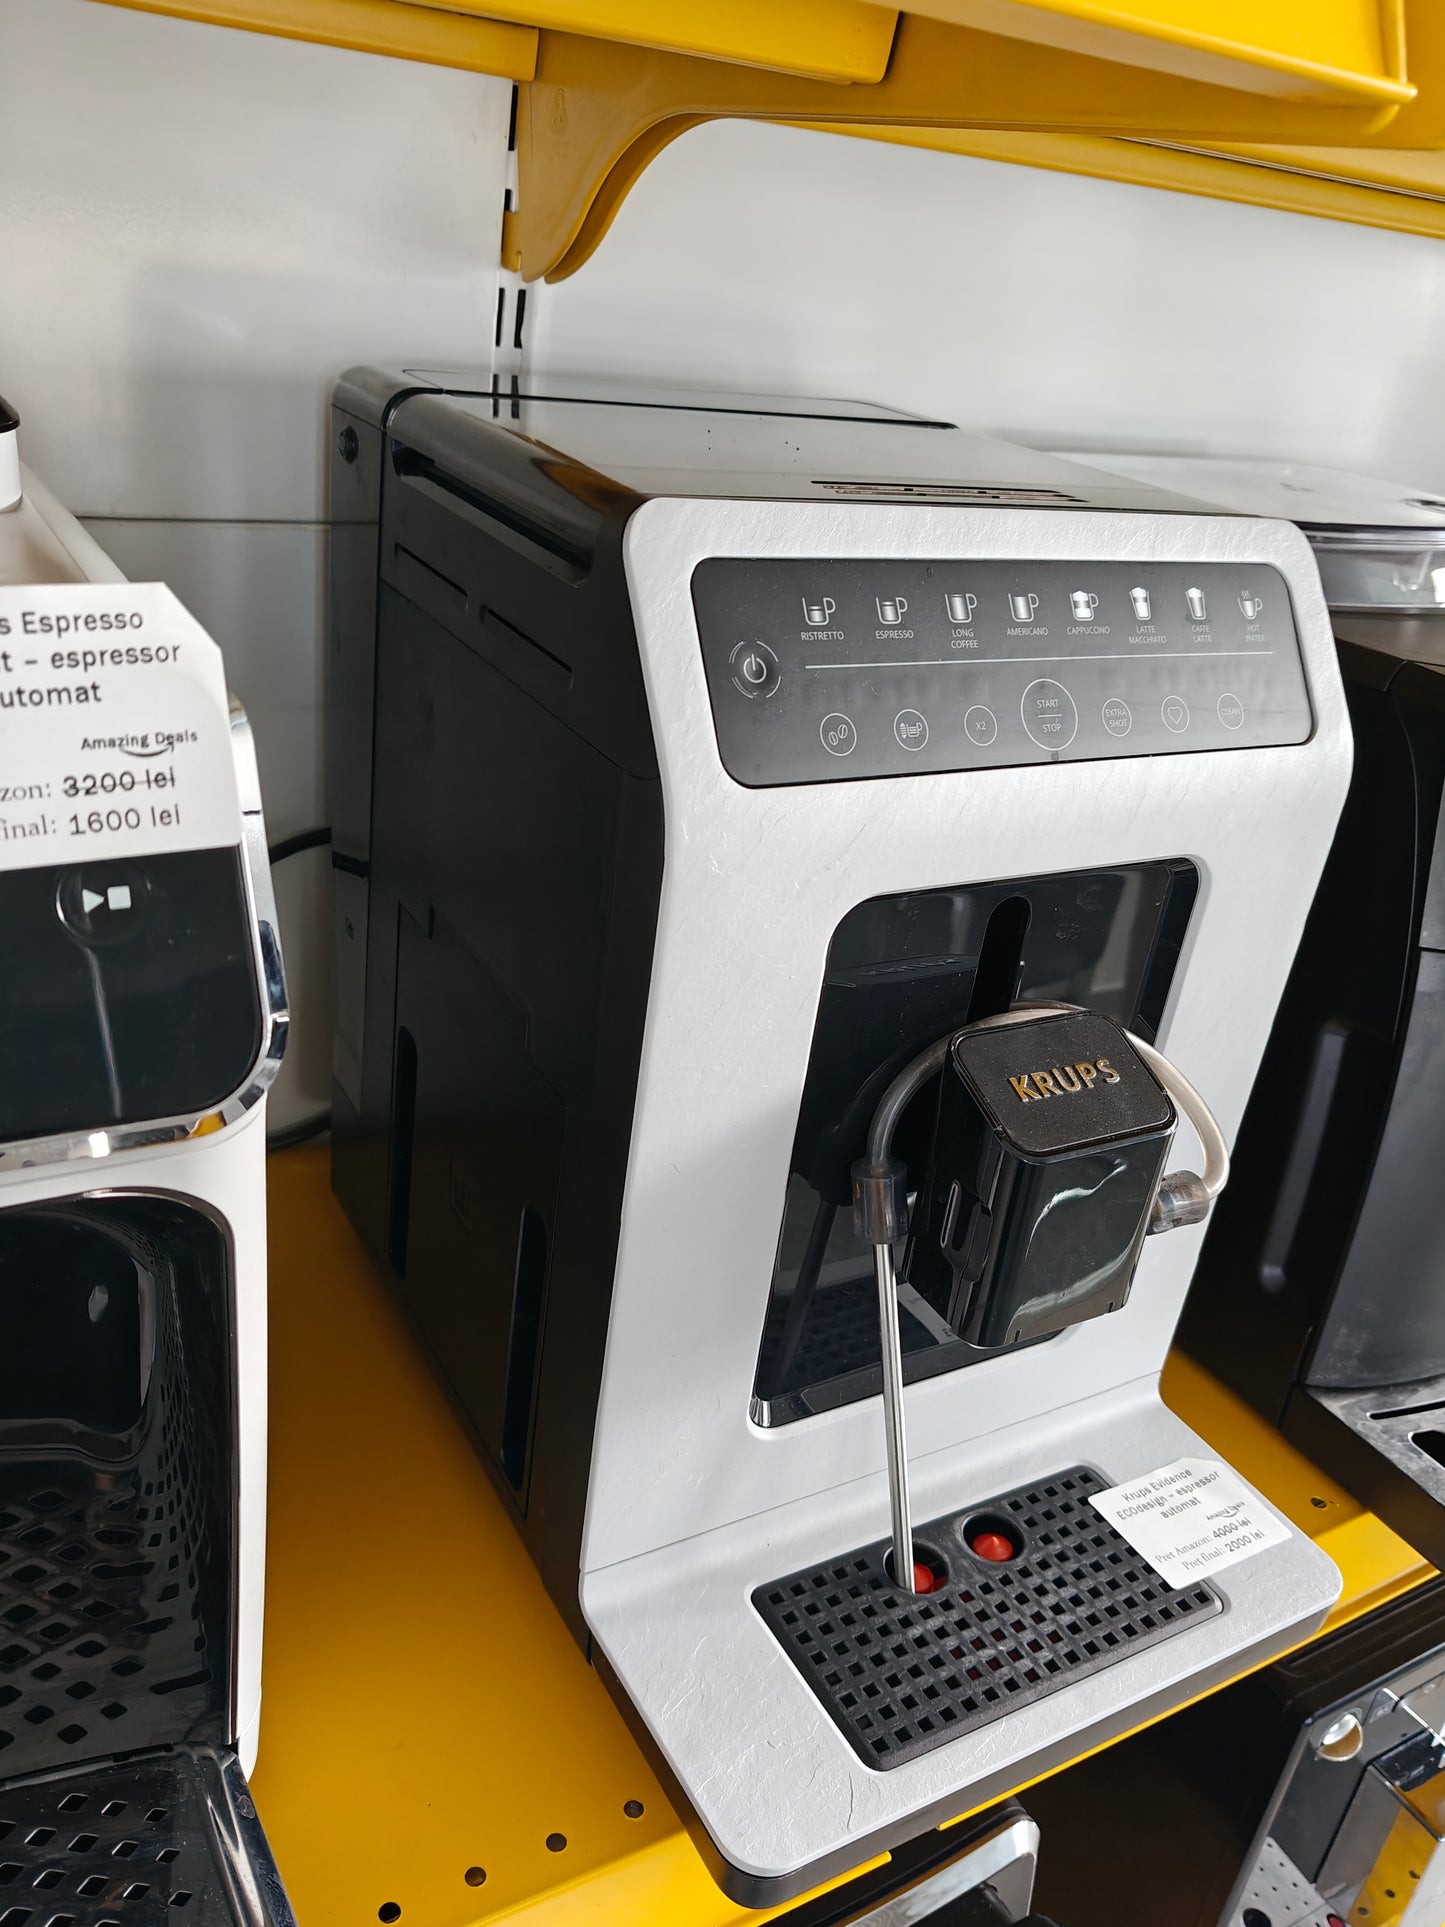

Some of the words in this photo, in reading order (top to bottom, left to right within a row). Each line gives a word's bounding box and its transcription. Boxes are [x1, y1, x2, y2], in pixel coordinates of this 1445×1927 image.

[22, 611, 143, 638] Espresso
[1192, 624, 1210, 633] CAFFE
[1247, 624, 1259, 633] HOT
[952, 629, 974, 637] LONG
[1007, 627, 1048, 636] AMERICANO
[1067, 626, 1110, 635] CAPPUCCINO
[1136, 625, 1155, 634] LATTE
[801, 631, 844, 641] RISTRETTO
[875, 630, 914, 639] ESPRESSO
[1193, 634, 1212, 643] LATTE
[1246, 634, 1265, 642] WATER
[1128, 635, 1166, 644] MACCHIATO
[951, 640, 978, 649] COFFEE
[51, 643, 181, 672] espressor
[1037, 699, 1059, 708] START
[1105, 709, 1127, 718] EXTRA
[1221, 707, 1241, 716] CLEAN
[976, 722, 986, 730] X2
[1109, 719, 1127, 727] SHOT
[1042, 724, 1061, 733] STOP
[81, 733, 149, 751] Amazing
[155, 729, 198, 745] Deals
[62, 771, 135, 798] 3200
[69, 808, 140, 836] 1600
[151, 804, 180, 827] lei
[1009, 1058, 1120, 1104] KRUPS
[1122, 1486, 1152, 1502] Krups
[1152, 1468, 1192, 1492] Evidence
[1116, 1495, 1167, 1521] ECOdesign
[1176, 1471, 1221, 1496] espressor
[1160, 1497, 1201, 1519] automat
[1176, 1536, 1211, 1557] Amazon:
[1213, 1523, 1239, 1539] 4000
[1200, 1546, 1225, 1563] final:
[1225, 1536, 1251, 1553] 2000
[1251, 1529, 1265, 1542] lei
